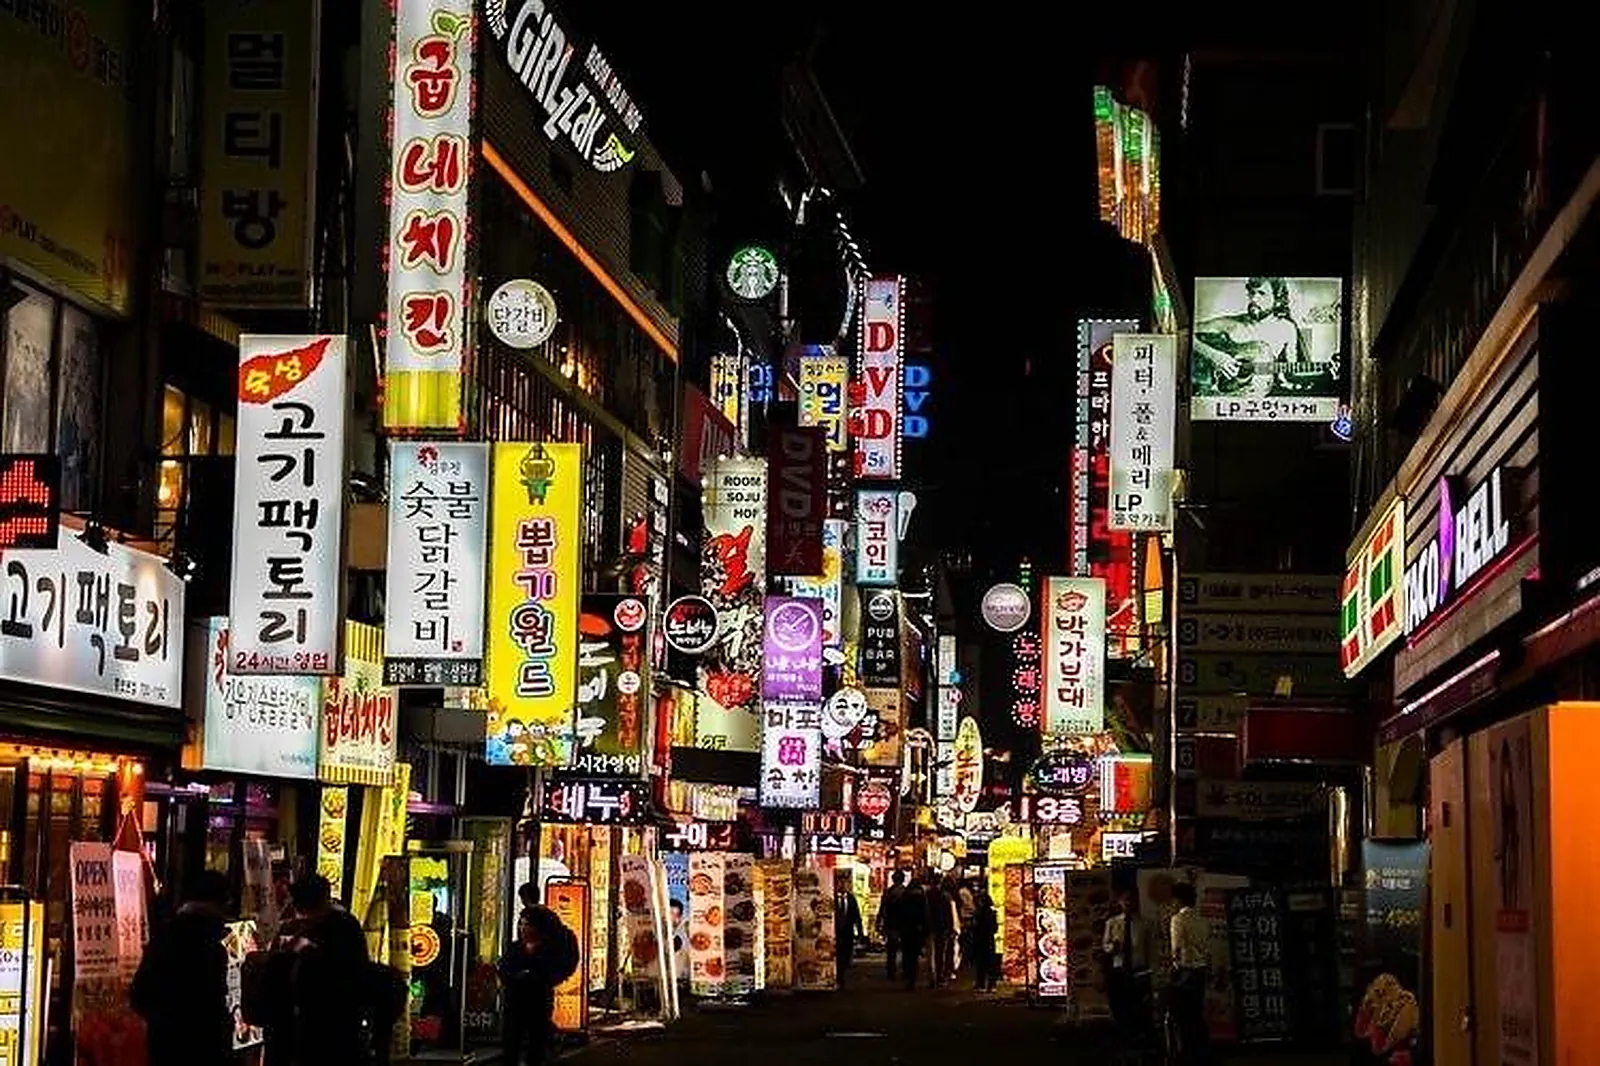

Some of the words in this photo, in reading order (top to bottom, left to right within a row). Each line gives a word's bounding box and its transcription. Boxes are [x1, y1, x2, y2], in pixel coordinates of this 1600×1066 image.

[224, 34, 287, 248] 멀티방
[400, 37, 465, 353] 굽네치킨
[864, 322, 895, 440] DVD
[902, 366, 931, 438] DVD
[1216, 402, 1240, 417] LP
[724, 476, 762, 487] ROOM
[726, 492, 761, 503] SOJU
[1115, 493, 1142, 511] LP
[258, 401, 326, 644] 고기팩토리
[866, 521, 887, 566] 코인
[1403, 538, 1440, 637] TACO
[1454, 465, 1510, 590] BELL
[412, 522, 459, 651] 닭갈비
[512, 520, 557, 698] 뽑기월드
[2, 560, 170, 676] 고기팩토리
[867, 628, 895, 638] PUB
[1056, 615, 1088, 709] 박가부대
[767, 708, 822, 730] 마포
[1038, 766, 1087, 784] 노래방
[1036, 796, 1083, 823] 3층
[76, 859, 108, 885] OPEN
